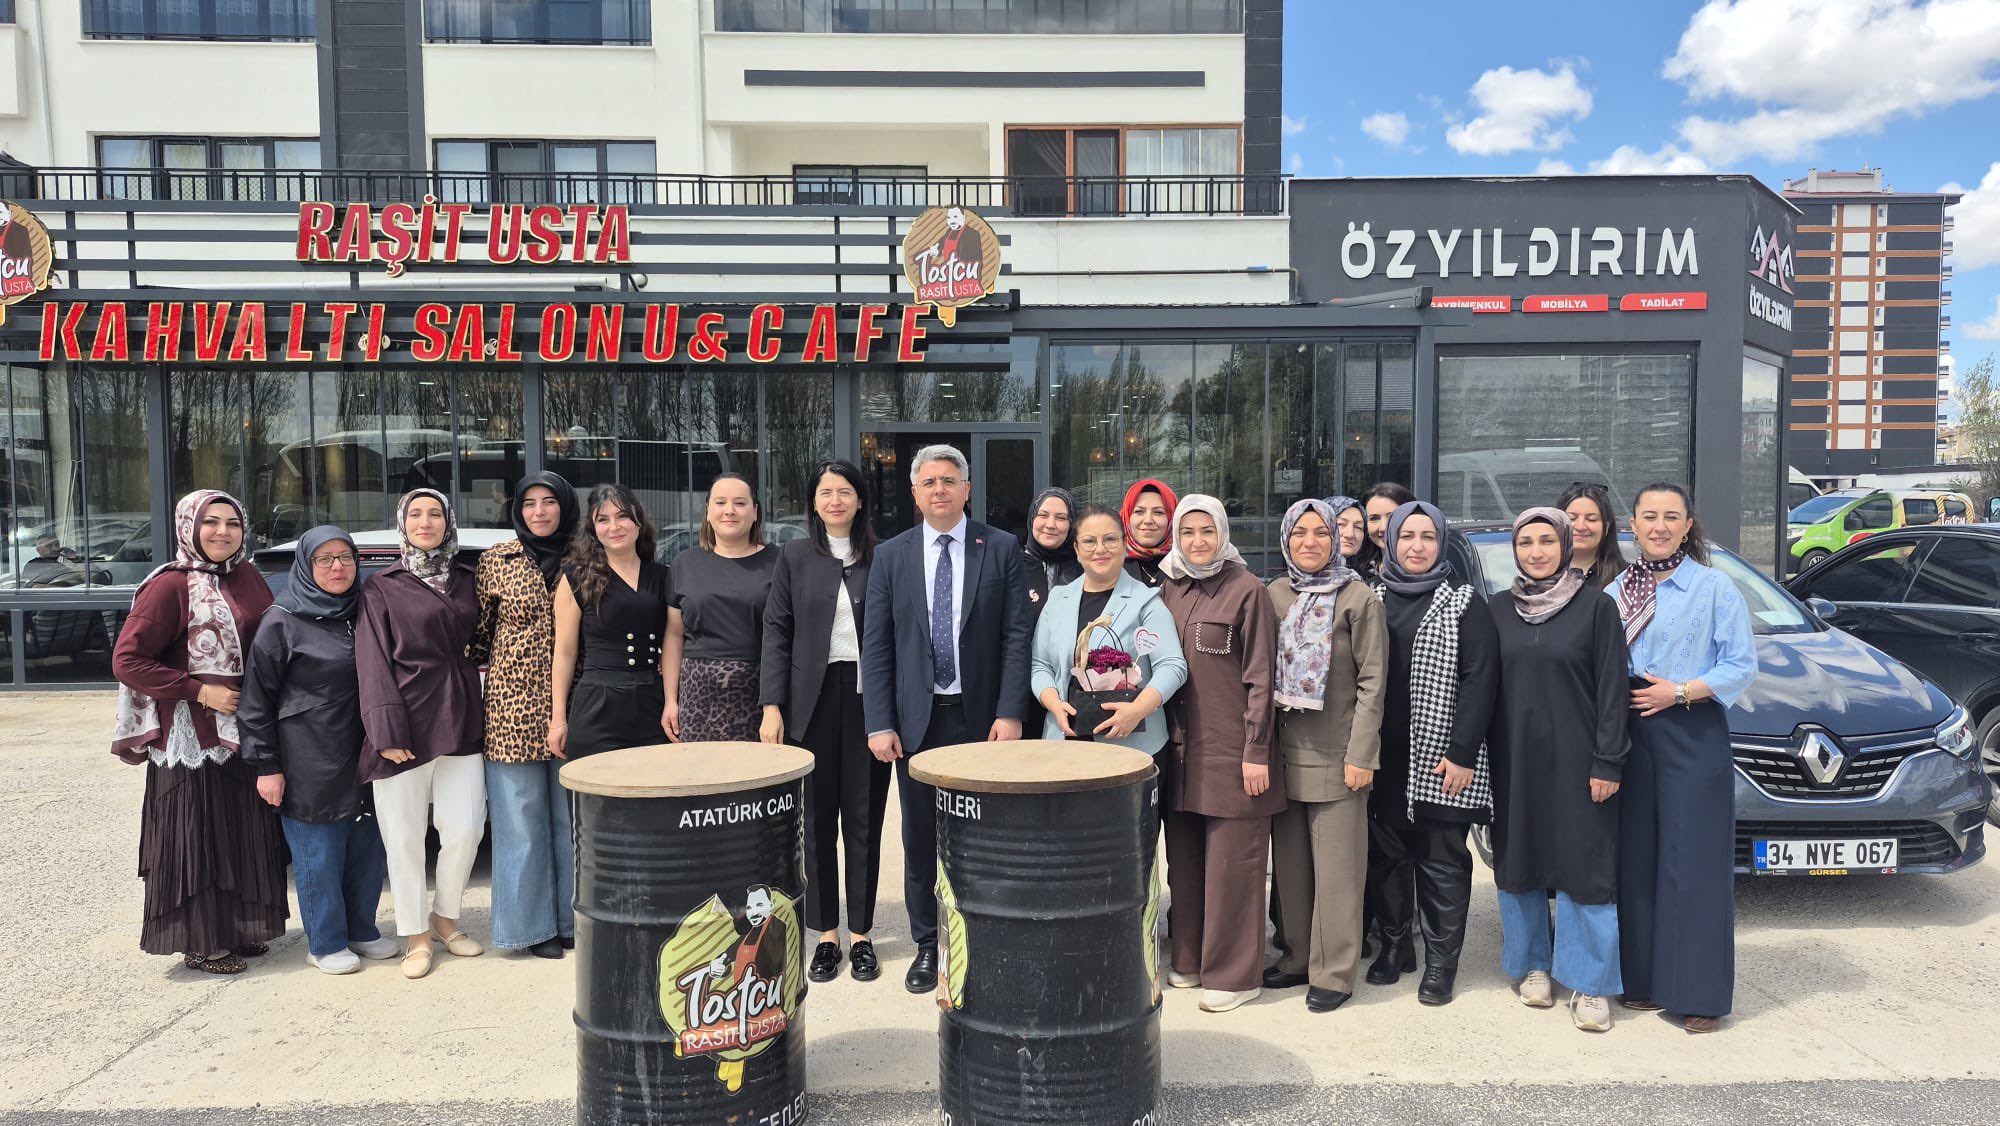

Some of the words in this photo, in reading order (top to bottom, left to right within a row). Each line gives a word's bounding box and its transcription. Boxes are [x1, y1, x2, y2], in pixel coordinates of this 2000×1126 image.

[296, 194, 472, 278] RAŞİT
[488, 203, 632, 265] USTA
[1341, 221, 1699, 279] ÖZYILDIRIM
[4, 281, 34, 294] USTA
[915, 249, 979, 298] Tostcu
[954, 284, 982, 296] USTA
[1541, 298, 1588, 309] MOBİLYA
[1640, 297, 1685, 308] TADİLAT
[1750, 284, 1792, 332] ÖZYILDIRIM
[39, 302, 386, 362] KAHVALTI
[679, 801, 763, 828] ATATÜRK
[767, 793, 795, 816] CAD.
[1756, 856, 1767, 864] TR
[1768, 843, 1793, 866] 34
[1806, 843, 1845, 866] NVE
[1856, 841, 1894, 865] 067
[680, 966, 783, 1045] Tostcu
[750, 1013, 786, 1039] USTA
